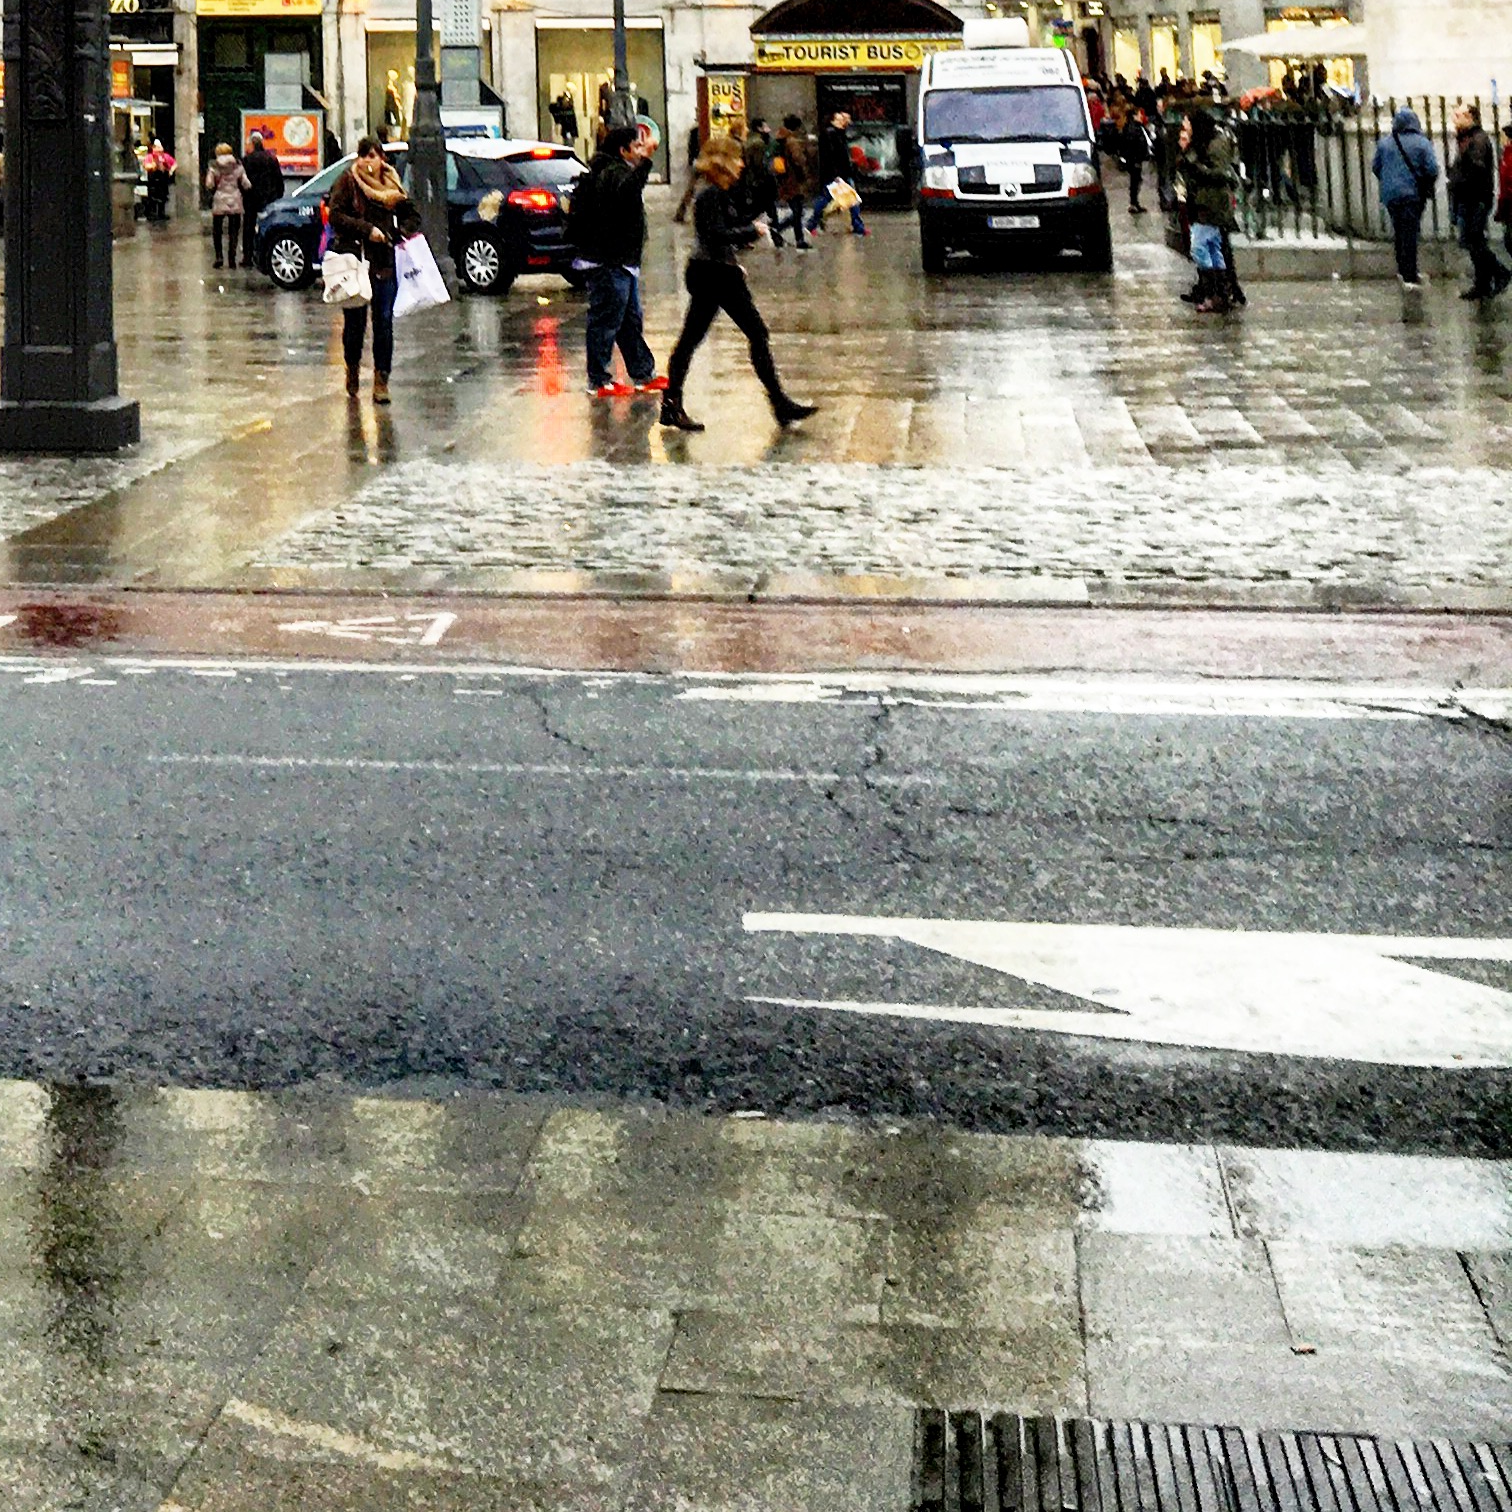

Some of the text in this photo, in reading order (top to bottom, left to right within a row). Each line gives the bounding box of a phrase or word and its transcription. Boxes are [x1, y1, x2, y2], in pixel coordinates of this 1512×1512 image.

[783, 44, 904, 61] TOURIST BUS
[711, 83, 742, 96] BUS
